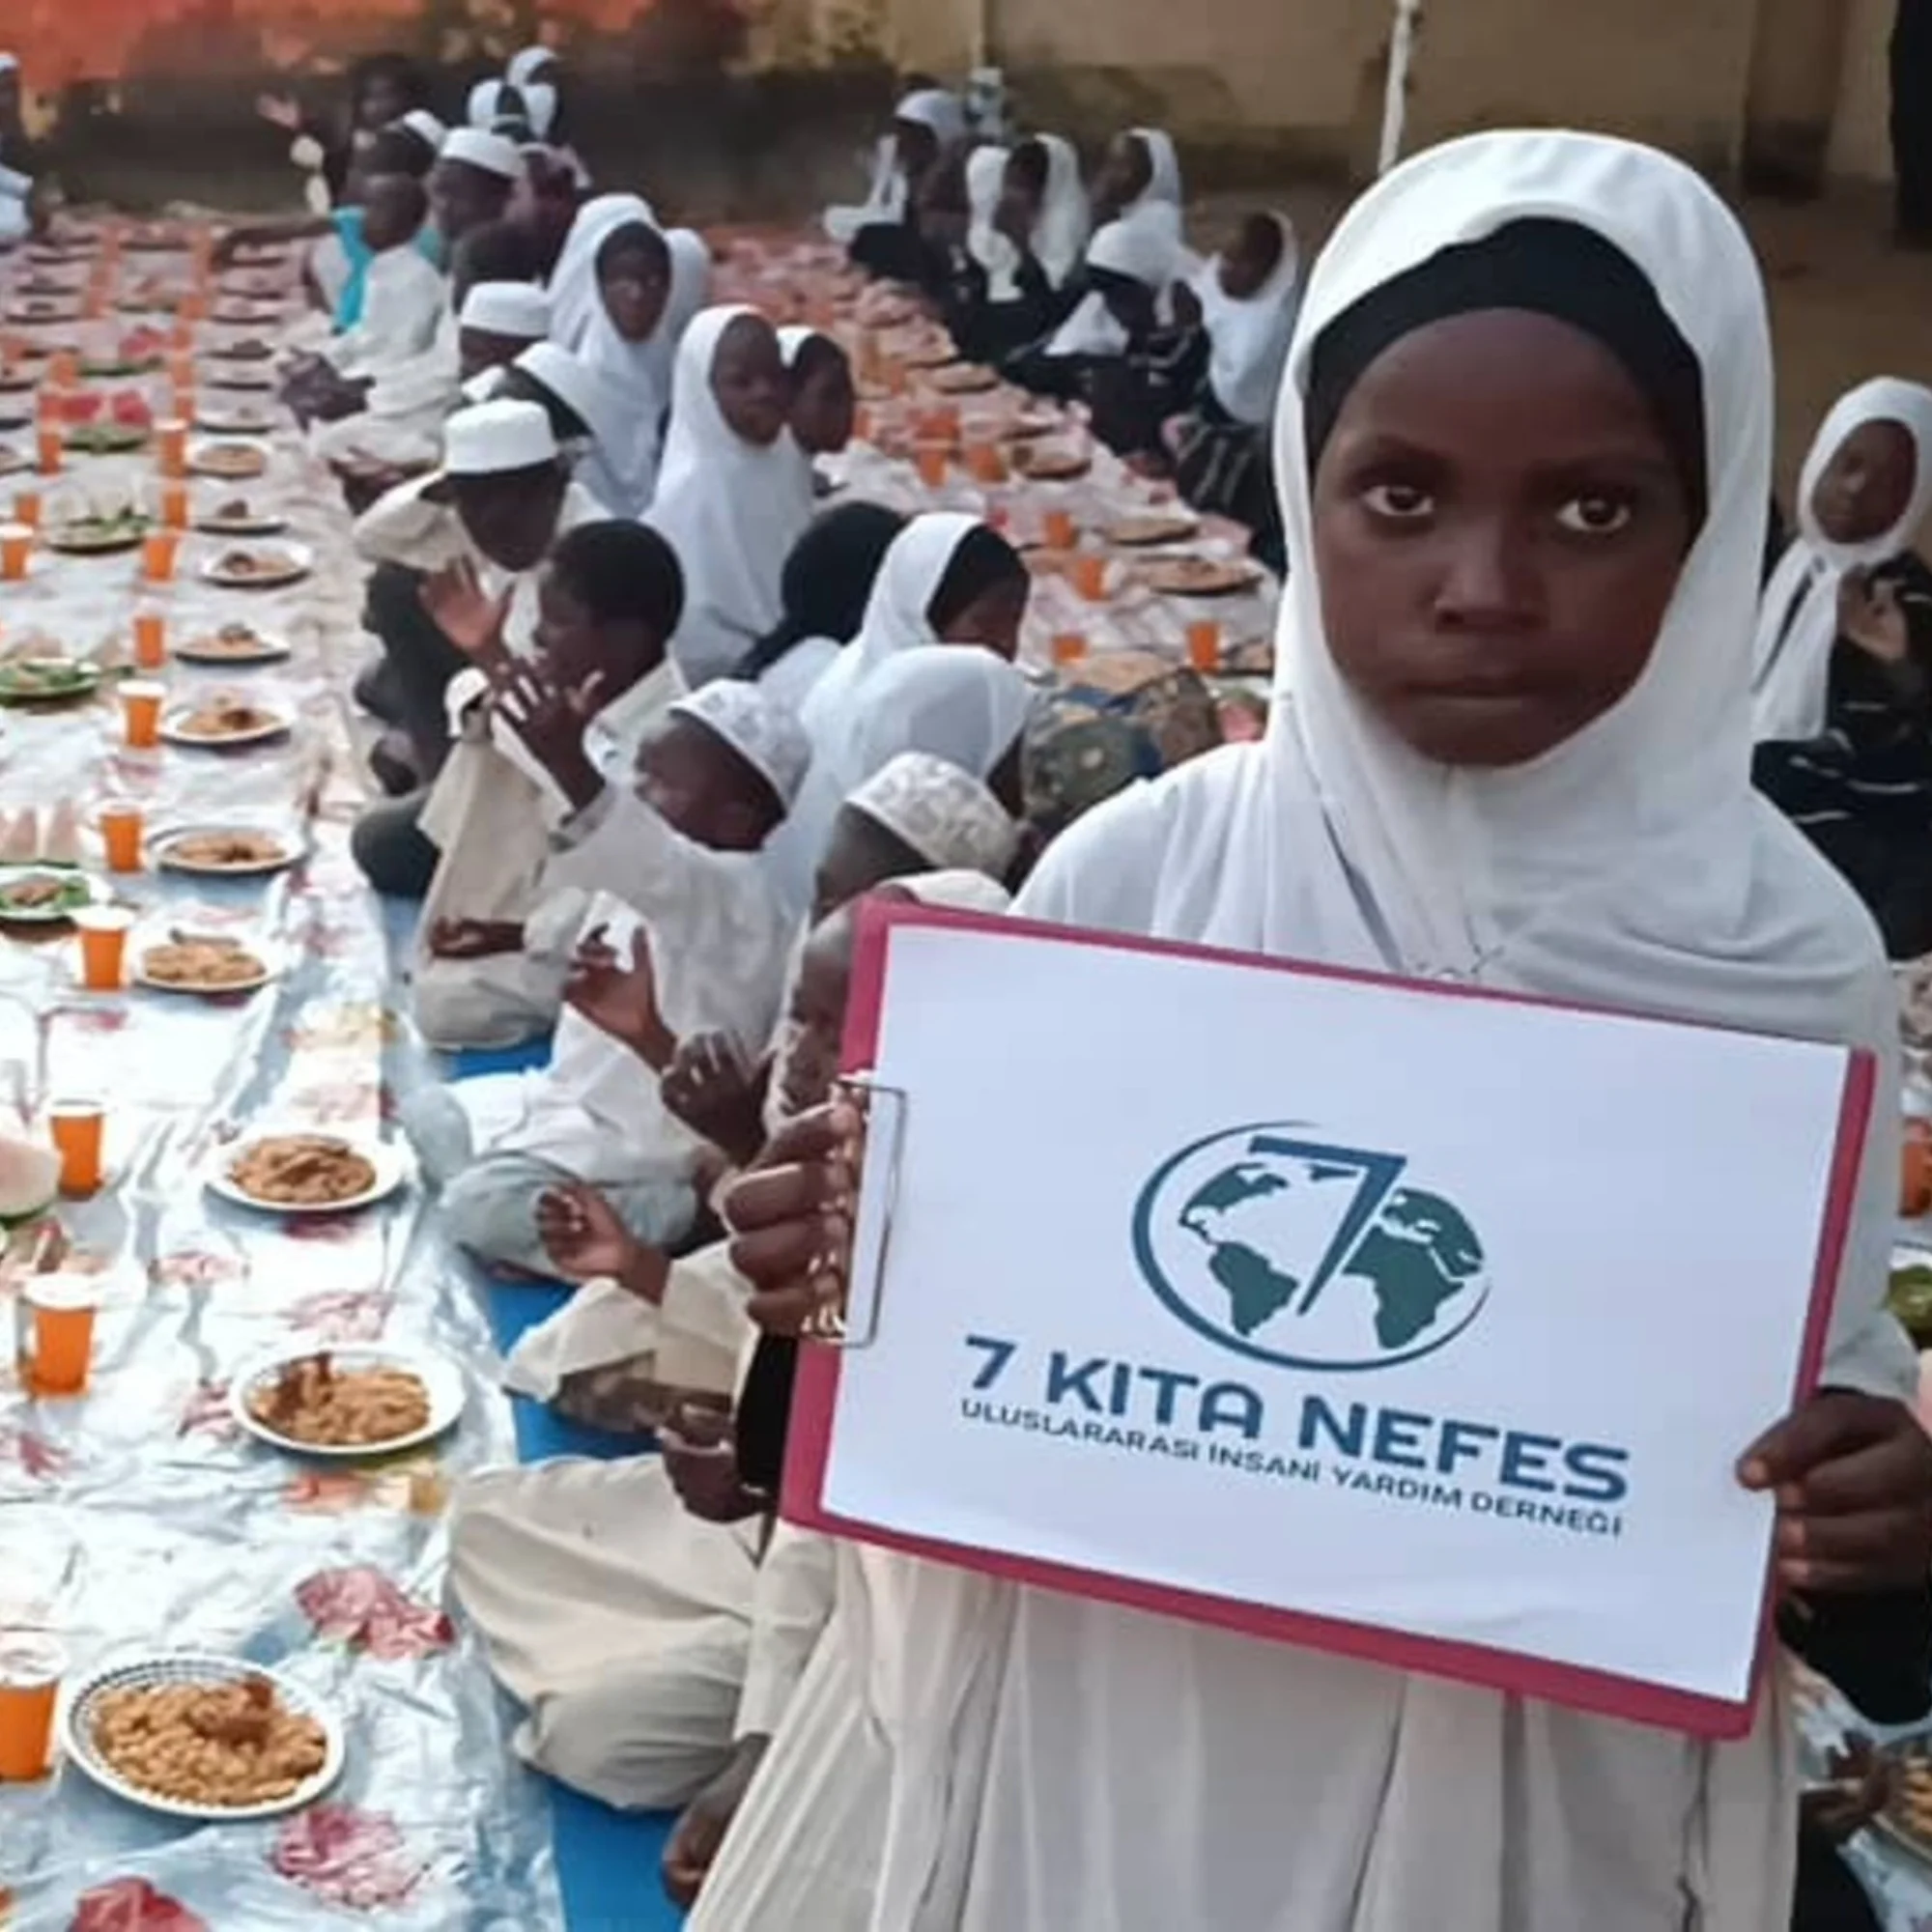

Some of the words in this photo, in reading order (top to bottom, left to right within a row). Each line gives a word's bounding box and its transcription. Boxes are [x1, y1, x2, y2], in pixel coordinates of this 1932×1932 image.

[1247, 1135, 1406, 1316] 7
[960, 1399, 1199, 1461] ULUSLARARASI
[1332, 1465, 1463, 1511] YARDIM
[965, 1335, 1017, 1390] 7
[1046, 1351, 1264, 1440] KITA
[1298, 1395, 1629, 1503] NEFES
